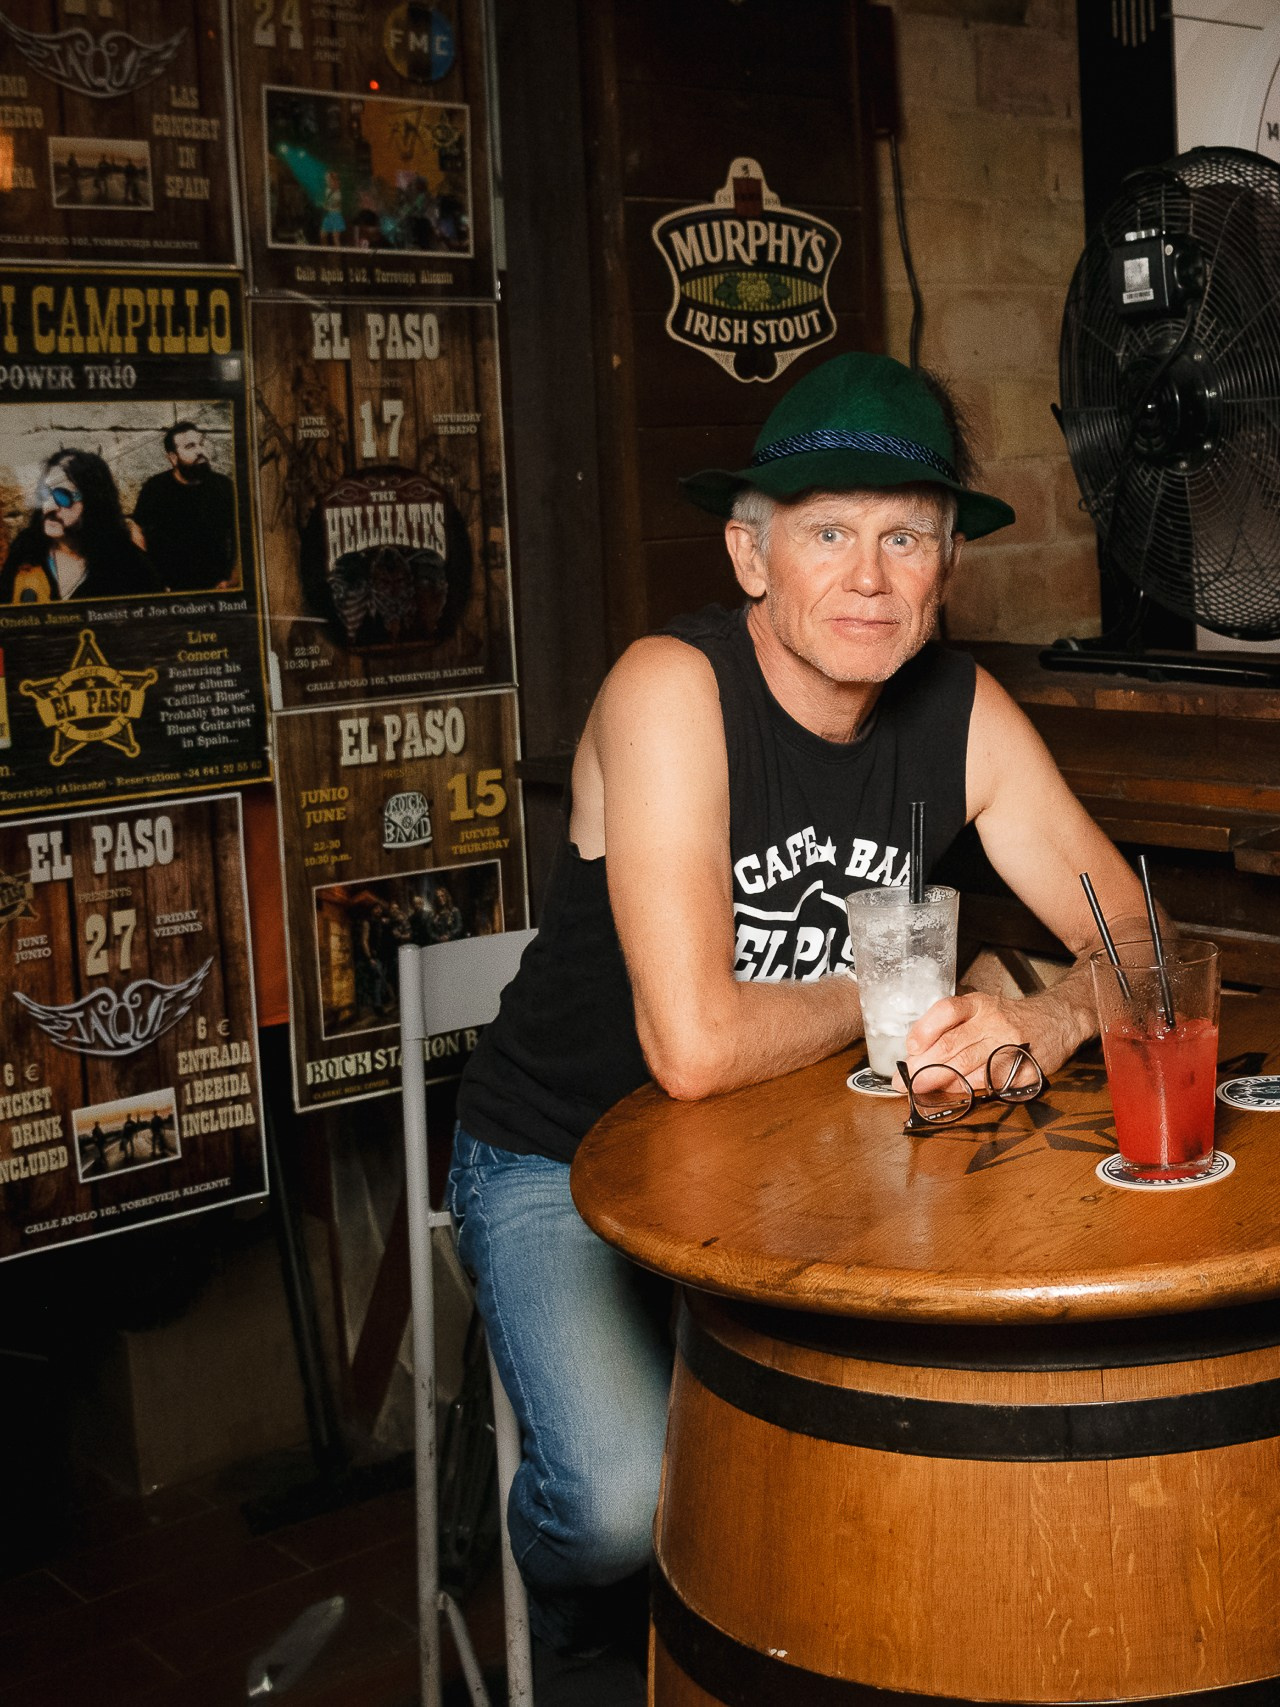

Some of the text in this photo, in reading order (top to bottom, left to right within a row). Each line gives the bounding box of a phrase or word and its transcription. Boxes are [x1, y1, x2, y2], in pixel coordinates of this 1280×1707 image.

[669, 218, 827, 274] MURPHY'S
[31, 284, 232, 355] CAMPILLO
[684, 307, 822, 345] IRISH STOUT
[312, 312, 441, 360] EL PASO
[360, 399, 405, 458] 17
[368, 490, 398, 502] THE
[87, 609, 128, 622] Bassist
[133, 607, 144, 618] of
[148, 605, 168, 617] Joe
[171, 602, 215, 615] Cocker's
[218, 599, 247, 612] Band
[186, 631, 217, 645] Live
[177, 647, 229, 662] Concert
[168, 663, 241, 679] Featuring his
[337, 678, 368, 689] APOLO
[442, 665, 485, 679] ALICANTE
[174, 679, 237, 693] new album:
[50, 690, 131, 721] EL PASO
[160, 703, 256, 723] Probably the best
[166, 718, 251, 736] Blues Guitarist
[338, 706, 466, 767] EL PASO
[181, 738, 194, 749] in
[115, 772, 182, 787] Reservations
[301, 786, 349, 809] JUNIO
[447, 768, 508, 821] 15
[305, 807, 347, 829] JUNE
[460, 826, 500, 843] JUEVES
[27, 815, 175, 884] EL PASO
[451, 837, 510, 856] THURSDAY
[733, 825, 822, 895] CAFE
[156, 909, 199, 926] FRIDAY
[153, 921, 204, 938] VIERNES
[17, 934, 48, 951] JUNE
[85, 908, 137, 977] 27
[734, 923, 789, 983] EL
[15, 947, 52, 965] JUNIO
[196, 1016, 231, 1040] 6 €
[177, 1041, 252, 1075] ENTRADA
[3, 1062, 40, 1088] 6 €
[11, 1115, 64, 1149] DRINK
[24, 1218, 60, 1235] CALLE
[60, 1209, 98, 1226] APOLO
[120, 1189, 181, 1213] TORREVIEJA
[182, 1176, 232, 1196] ALICANTE
